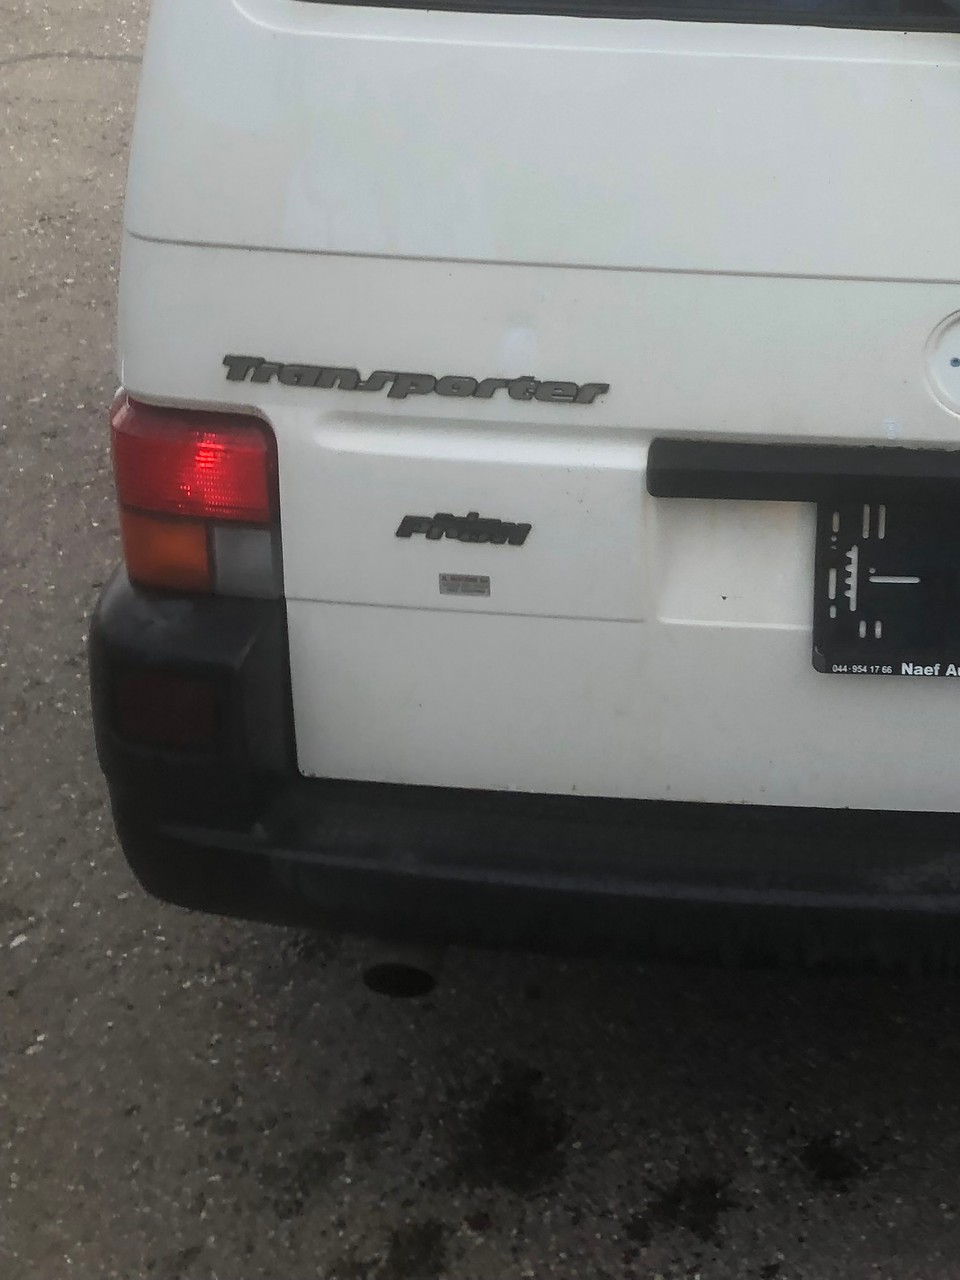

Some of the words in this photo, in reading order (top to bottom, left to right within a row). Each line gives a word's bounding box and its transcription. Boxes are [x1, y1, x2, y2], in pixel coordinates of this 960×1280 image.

[222, 354, 610, 404] Transporter
[870, 665, 880, 674] 17
[881, 665, 893, 674] 66
[901, 662, 940, 676] Naef
